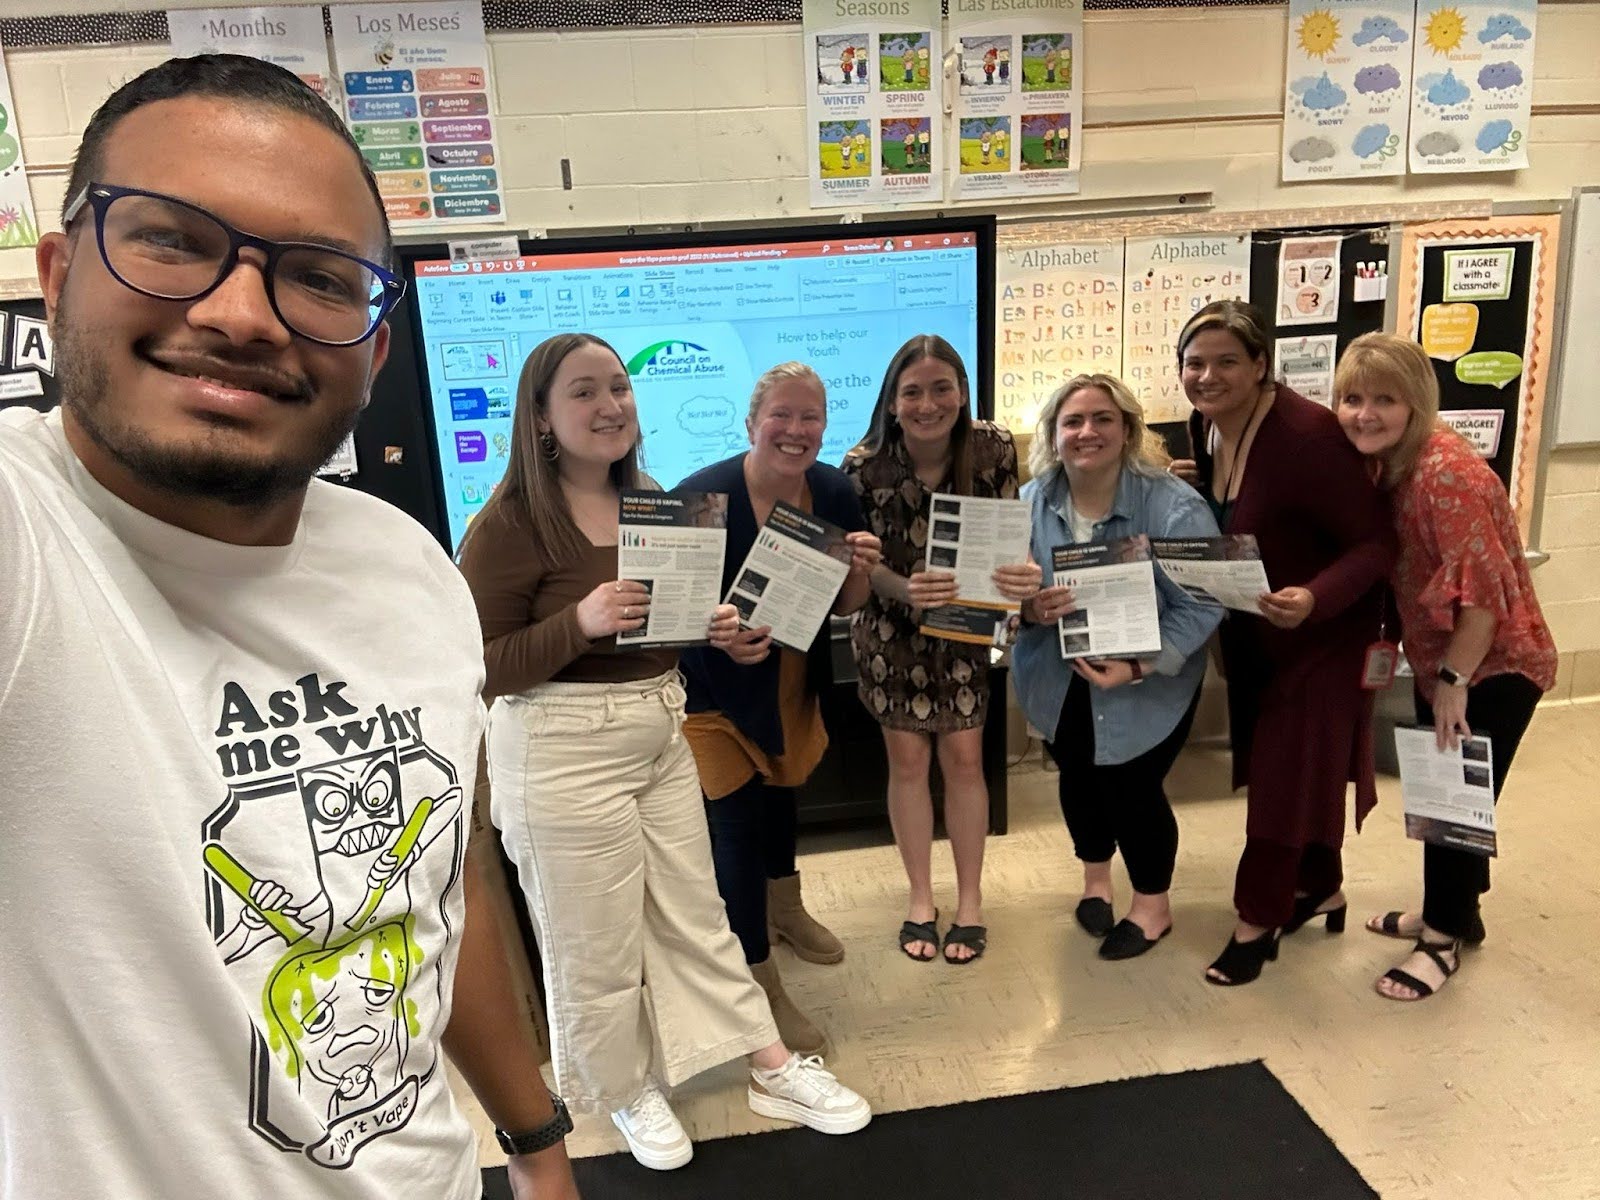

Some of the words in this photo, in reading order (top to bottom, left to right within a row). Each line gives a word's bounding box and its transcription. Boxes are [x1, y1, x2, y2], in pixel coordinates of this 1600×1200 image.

[836, 0, 910, 16] Seasons
[958, 0, 985, 12] Las
[992, 0, 1074, 11] Estaciones
[209, 16, 287, 39] Months
[357, 15, 391, 33] Los
[399, 12, 460, 32] Meses
[365, 76, 393, 84] Enero
[438, 99, 470, 107] Agosto
[823, 95, 865, 106] WINTER
[886, 93, 925, 103] SPRING
[971, 95, 1005, 104] INVIERNO
[365, 101, 400, 110] Febrero
[431, 123, 483, 133] Septiembre
[1318, 118, 1344, 126] SNOWY
[379, 152, 401, 160] Abril
[443, 149, 478, 158] Octubre
[1308, 165, 1334, 173] FOGGY
[440, 174, 487, 183] Noviembre
[823, 179, 870, 190] SUMMER
[883, 176, 929, 186] AUTUMN
[385, 202, 410, 210] Junio
[444, 198, 489, 207] Diciembre
[471, 241, 502, 250] computer
[1151, 241, 1228, 262] Alphabet
[1021, 247, 1100, 271] Alphabet
[1458, 260, 1465, 268] If
[1471, 258, 1499, 267] AGREE
[1300, 266, 1306, 283] 1
[1324, 265, 1332, 280] 2
[1464, 271, 1483, 279] with
[1132, 280, 1142, 292] a
[1162, 275, 1172, 290] b
[1192, 277, 1201, 288] c
[1221, 270, 1232, 286] d
[1003, 285, 1014, 300] A
[1033, 283, 1045, 298] B
[1062, 281, 1075, 296] C
[1093, 280, 1105, 294] D
[1132, 303, 1142, 314] e
[1163, 297, 1170, 311] f
[1190, 297, 1200, 312] g
[1311, 292, 1319, 307] 3
[1003, 307, 1014, 322] E
[1033, 305, 1044, 320] F
[1062, 303, 1074, 318] G
[1092, 301, 1104, 316] H
[777, 332, 804, 344] How
[806, 332, 818, 342] to
[821, 329, 846, 342] help
[849, 329, 868, 339] our
[1004, 329, 1011, 344] I
[1032, 327, 1042, 342] J
[1062, 325, 1073, 340] K
[1093, 323, 1102, 338] L
[21, 327, 47, 360] A
[1161, 343, 1170, 355] n
[807, 345, 840, 357] Youth
[1002, 351, 1015, 365] M
[1032, 349, 1043, 363] N
[1061, 347, 1073, 361] O
[1092, 345, 1103, 360] P
[660, 355, 695, 366] Council
[698, 356, 711, 364] on
[647, 365, 691, 376] Chemical
[694, 363, 725, 373] Abuse
[846, 373, 872, 388] the
[1002, 372, 1015, 387] Q
[1033, 370, 1044, 385] R
[829, 398, 849, 413] pe
[1003, 394, 1014, 408] U
[1455, 420, 1495, 429] DISAGREE
[215, 672, 359, 737] Ask
[216, 734, 301, 778] me
[315, 703, 423, 756] why
[329, 1145, 334, 1160] I
[335, 1121, 367, 1156] Don't
[372, 1096, 409, 1127] Vape
